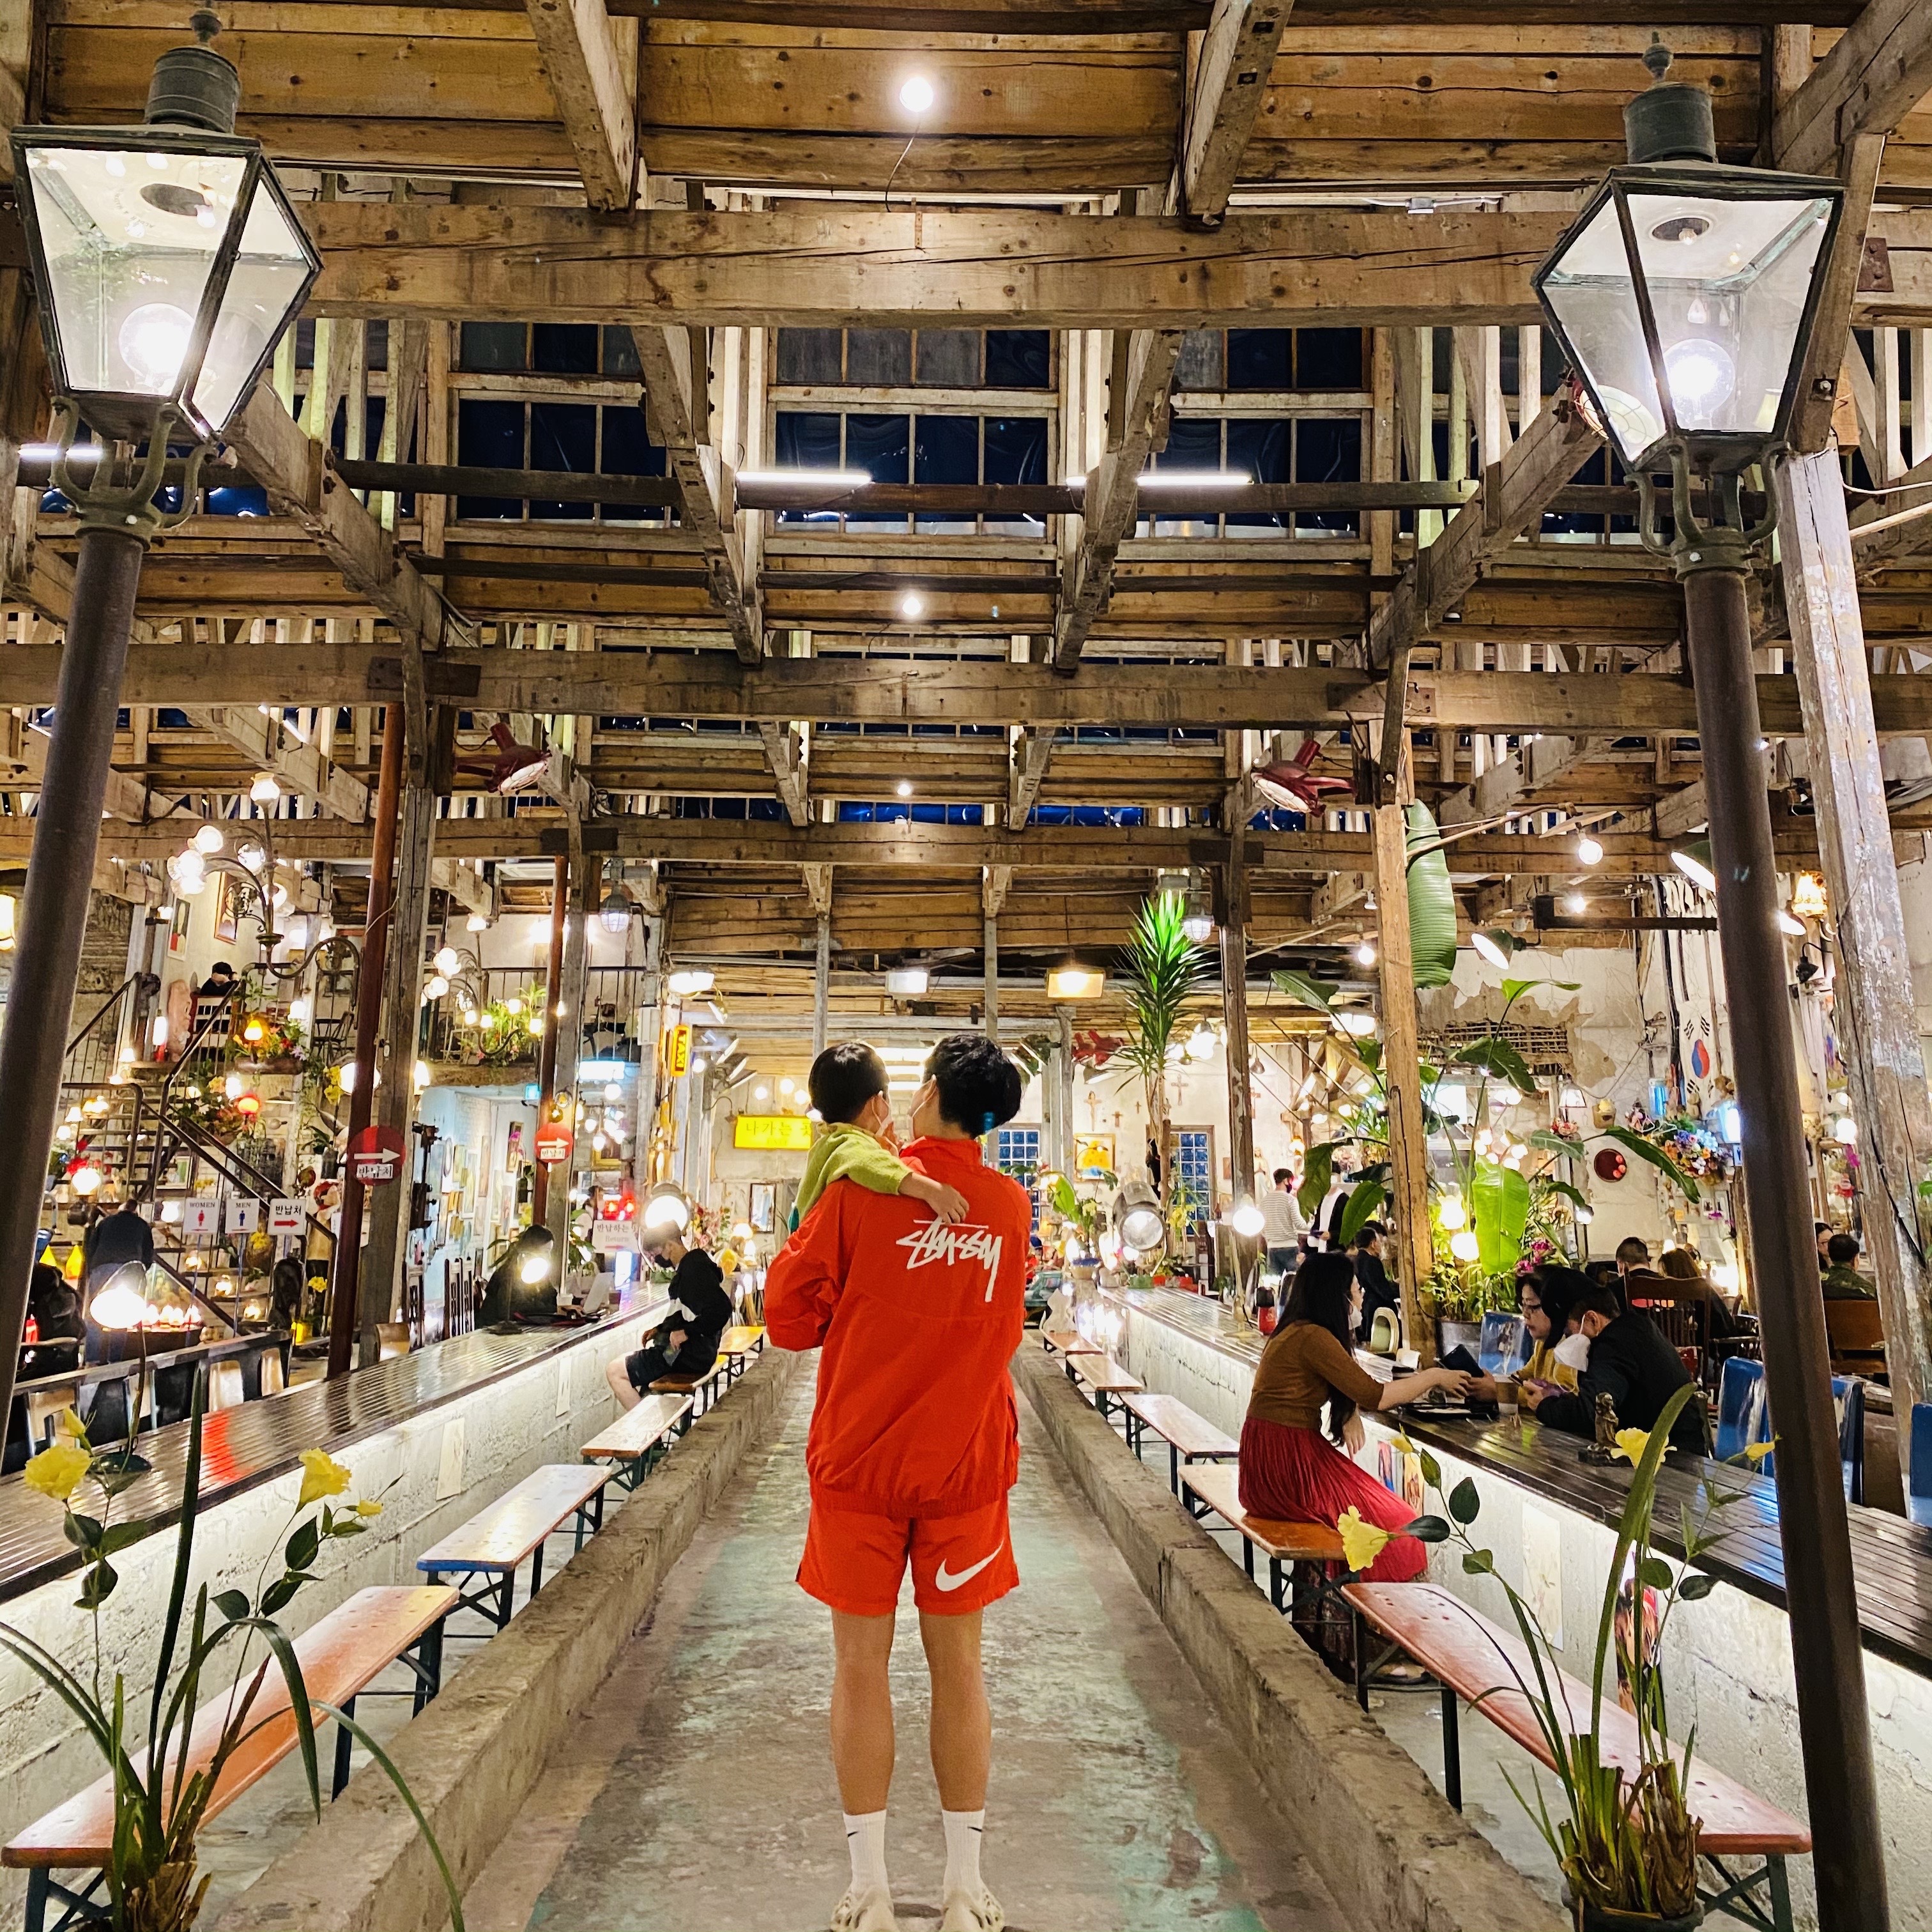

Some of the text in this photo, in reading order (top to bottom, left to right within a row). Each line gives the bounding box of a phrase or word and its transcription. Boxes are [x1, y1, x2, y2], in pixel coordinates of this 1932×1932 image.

[676, 1034, 686, 1068] TAXI
[746, 1121, 792, 1136] 나가는
[275, 1205, 302, 1215] 반납처
[597, 1223, 629, 1232] 반납하는
